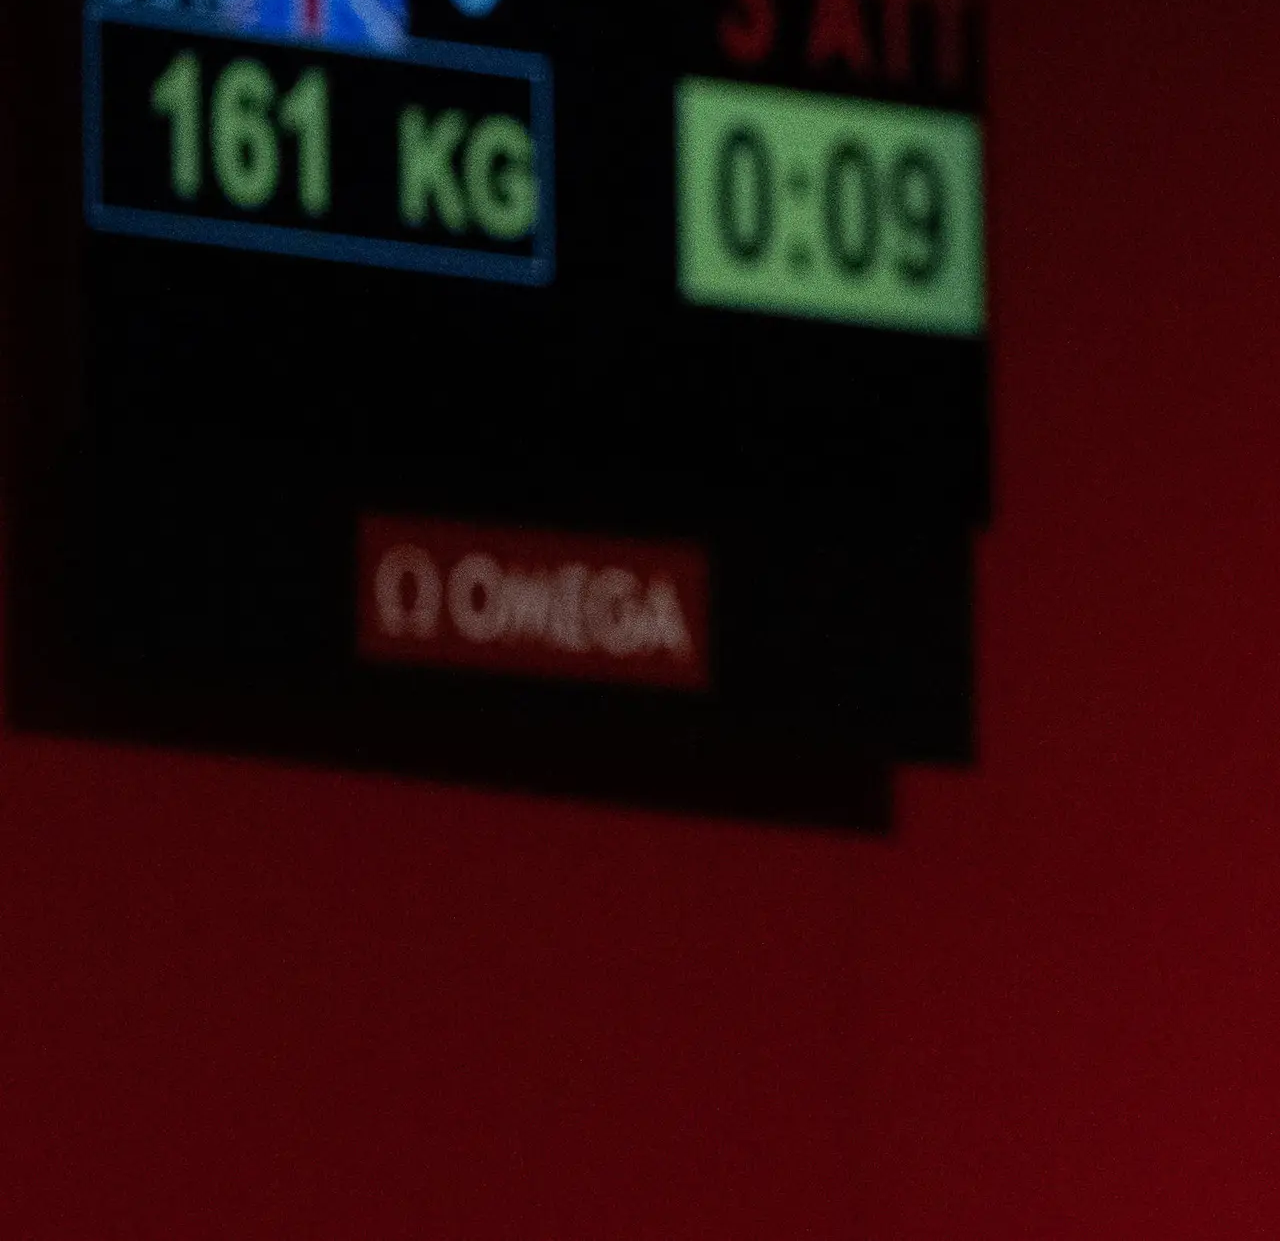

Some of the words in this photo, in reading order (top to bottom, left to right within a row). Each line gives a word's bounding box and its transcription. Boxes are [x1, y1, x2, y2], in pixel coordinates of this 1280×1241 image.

[152, 49, 332, 219] 161
[398, 105, 540, 241] KG
[714, 122, 952, 289] 0:09
